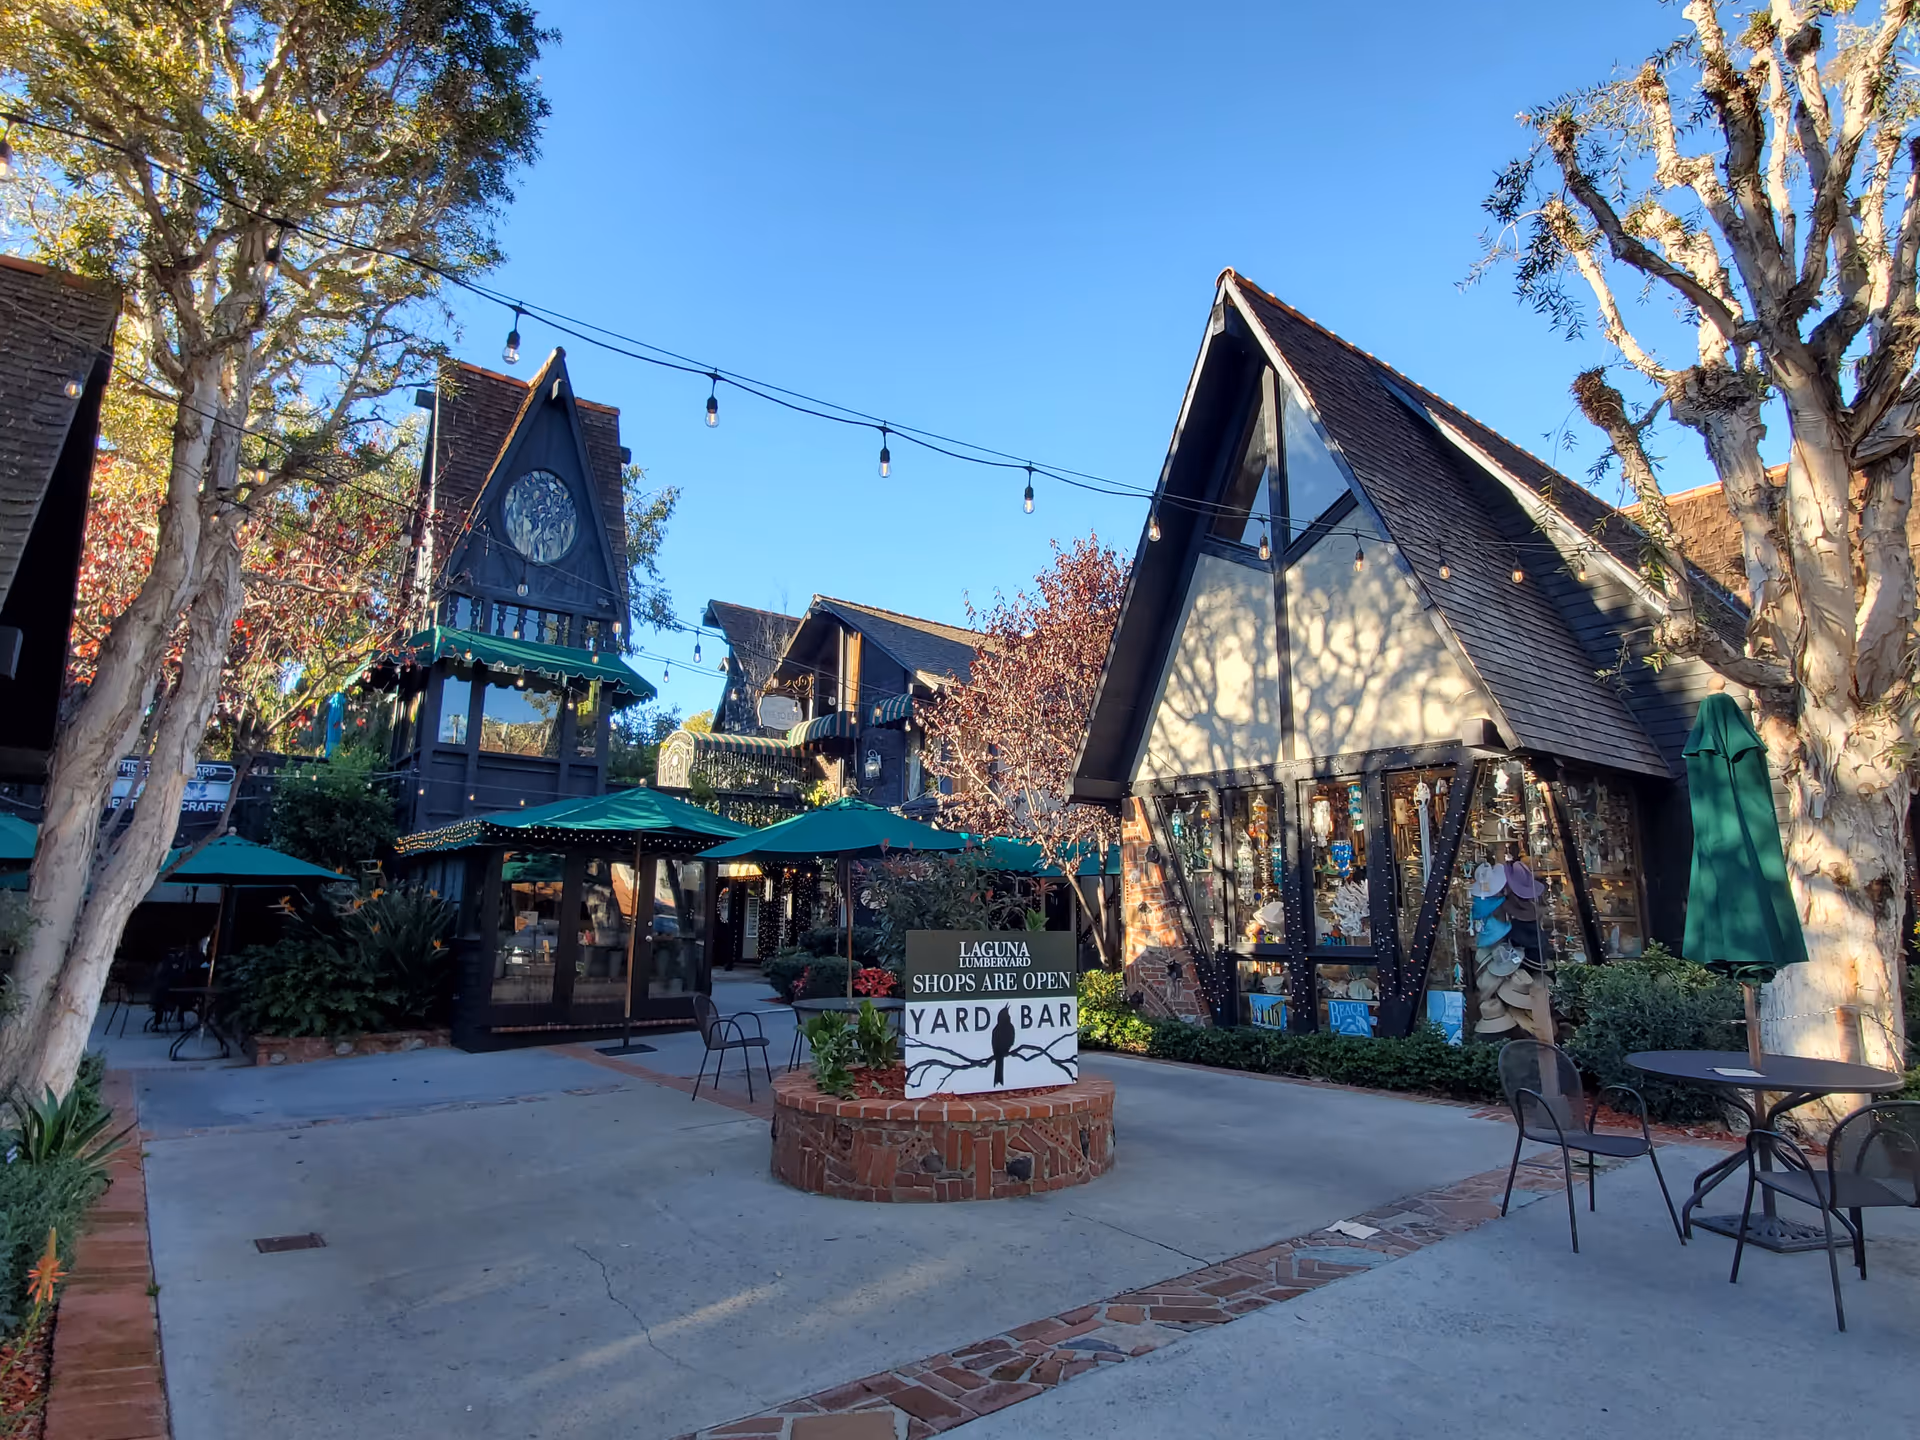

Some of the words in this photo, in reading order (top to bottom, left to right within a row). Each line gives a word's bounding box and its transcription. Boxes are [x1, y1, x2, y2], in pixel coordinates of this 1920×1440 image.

[180, 801, 227, 812] CRAFTS
[959, 941, 1030, 957] LAGUNA
[959, 957, 1031, 968] LUMBERYARD
[912, 973, 976, 993] SHOPS
[980, 972, 1018, 991] ARE
[1022, 971, 1072, 990] OPEN
[909, 1007, 991, 1035] YARD
[1020, 1003, 1072, 1029] BAR
[1329, 1001, 1365, 1025] BEACH
